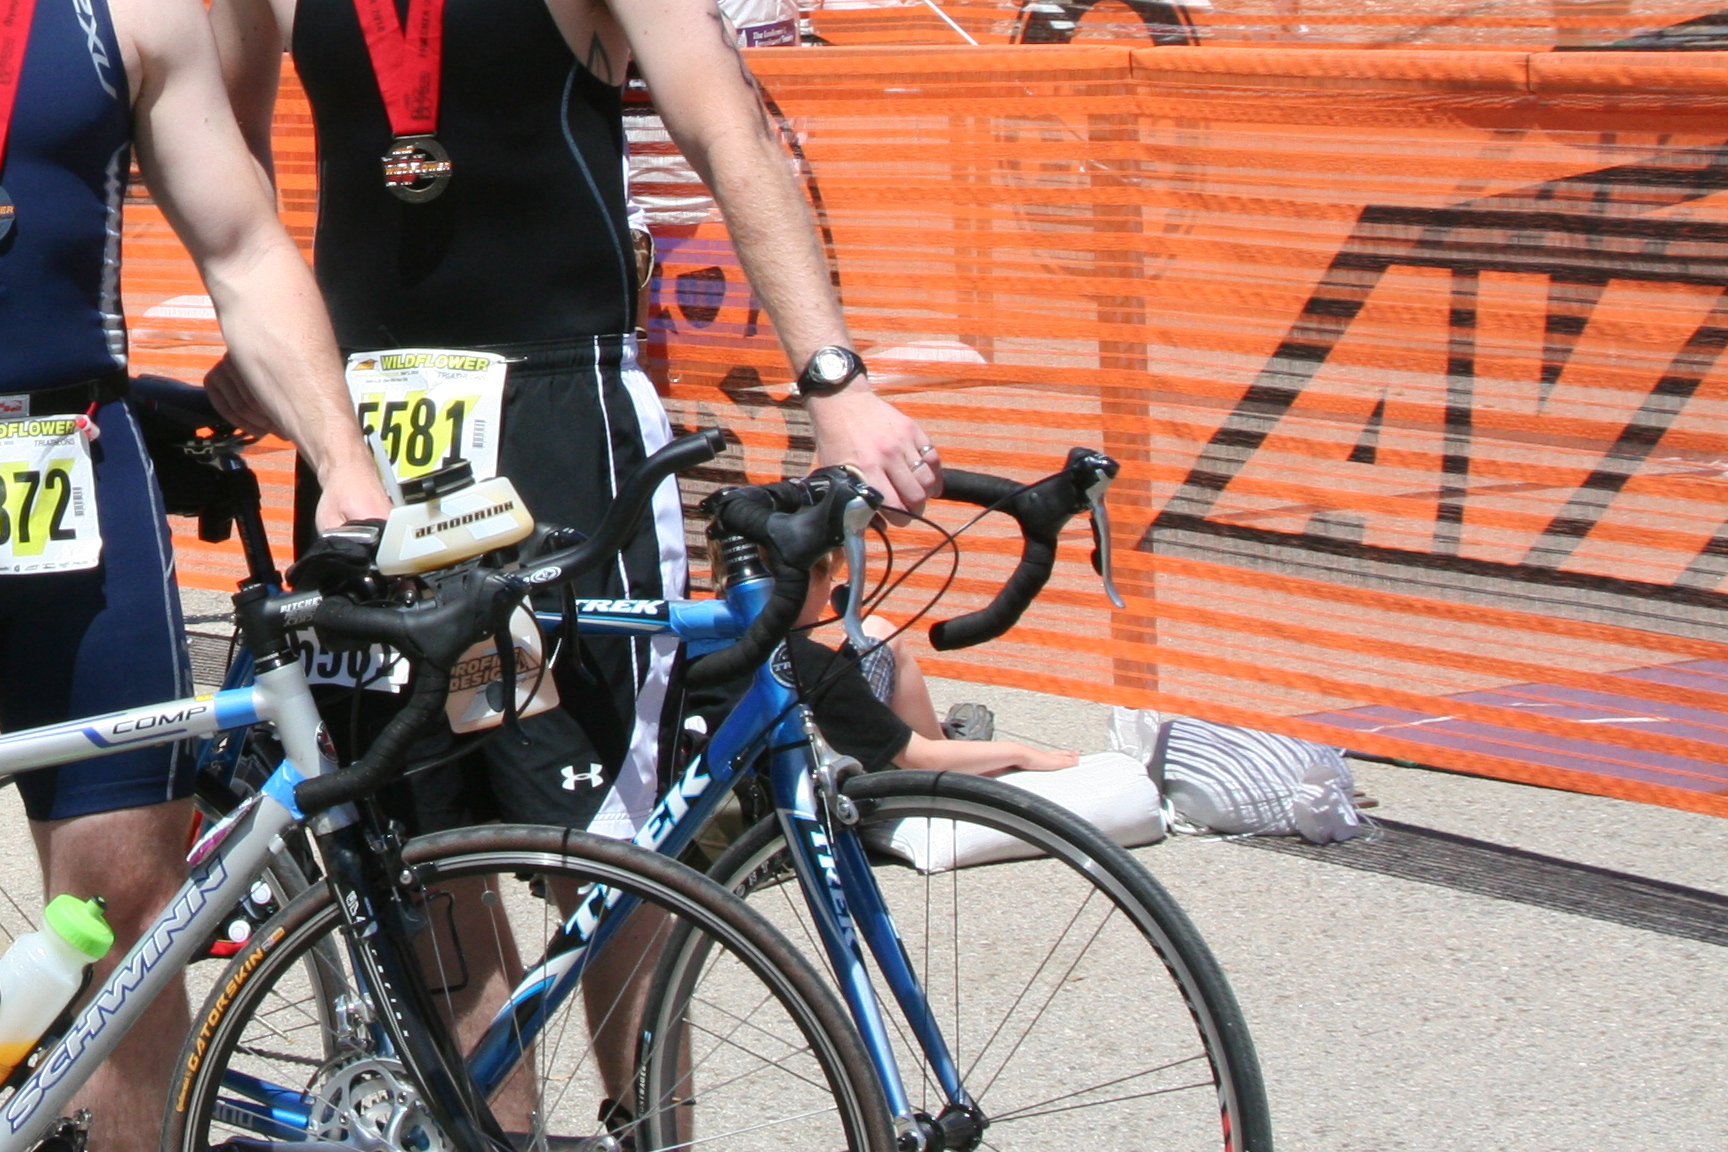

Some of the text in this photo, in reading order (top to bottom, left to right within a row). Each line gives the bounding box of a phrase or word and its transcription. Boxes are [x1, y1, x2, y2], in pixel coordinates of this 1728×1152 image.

[380, 353, 490, 372] WILDFLOWER
[575, 598, 667, 616] TREK
[112, 705, 208, 736] COMP
[7, 854, 230, 1134] SCHWINN
[187, 947, 266, 1073] GATORSKIN
